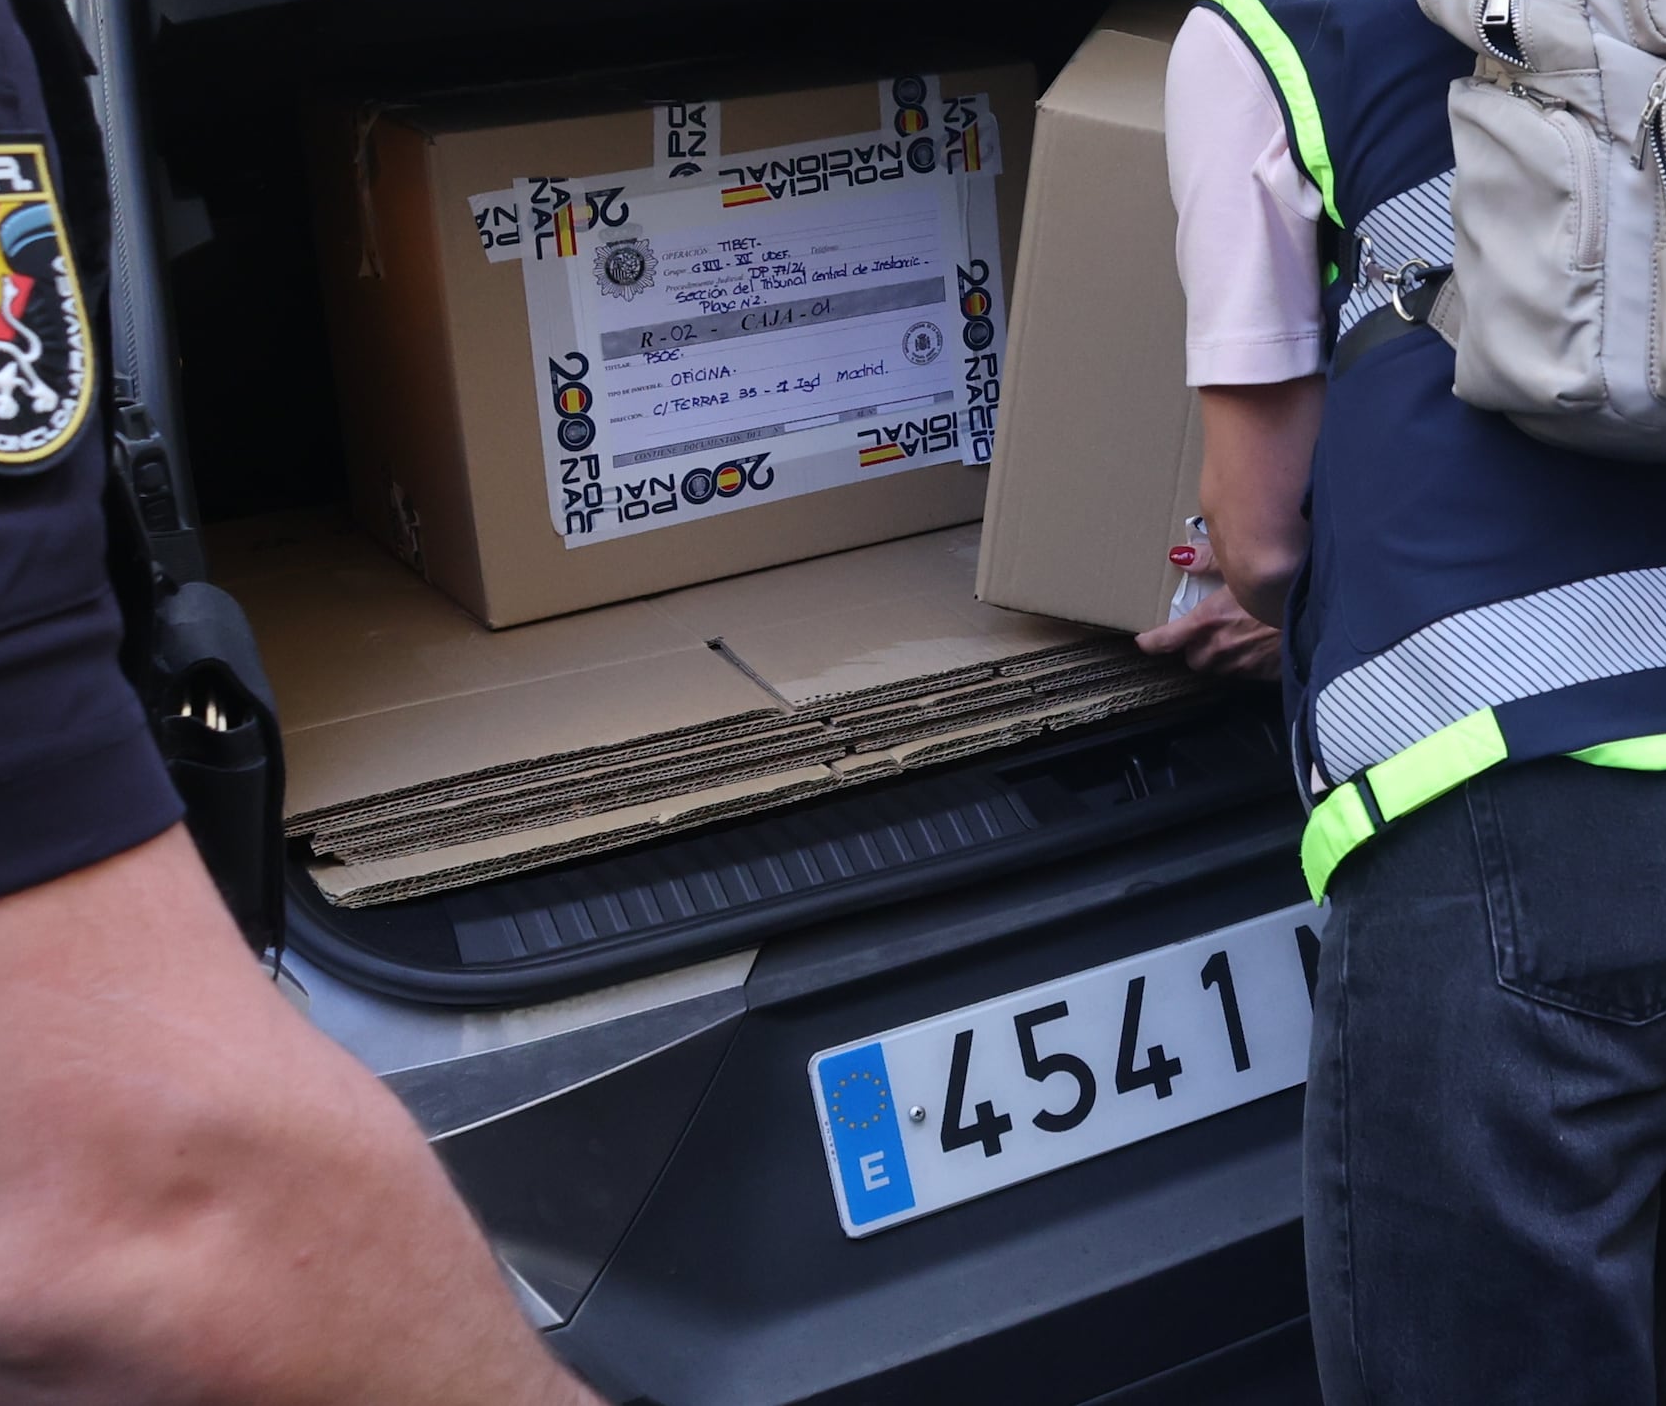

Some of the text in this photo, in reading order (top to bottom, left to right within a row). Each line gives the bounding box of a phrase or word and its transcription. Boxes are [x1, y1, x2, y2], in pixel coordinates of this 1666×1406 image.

[718, 140, 903, 186] NACIONAL
[640, 330, 654, 349] R
[741, 307, 794, 331] CAJA
[938, 949, 1251, 1159] 4541
[859, 1149, 890, 1192] E
